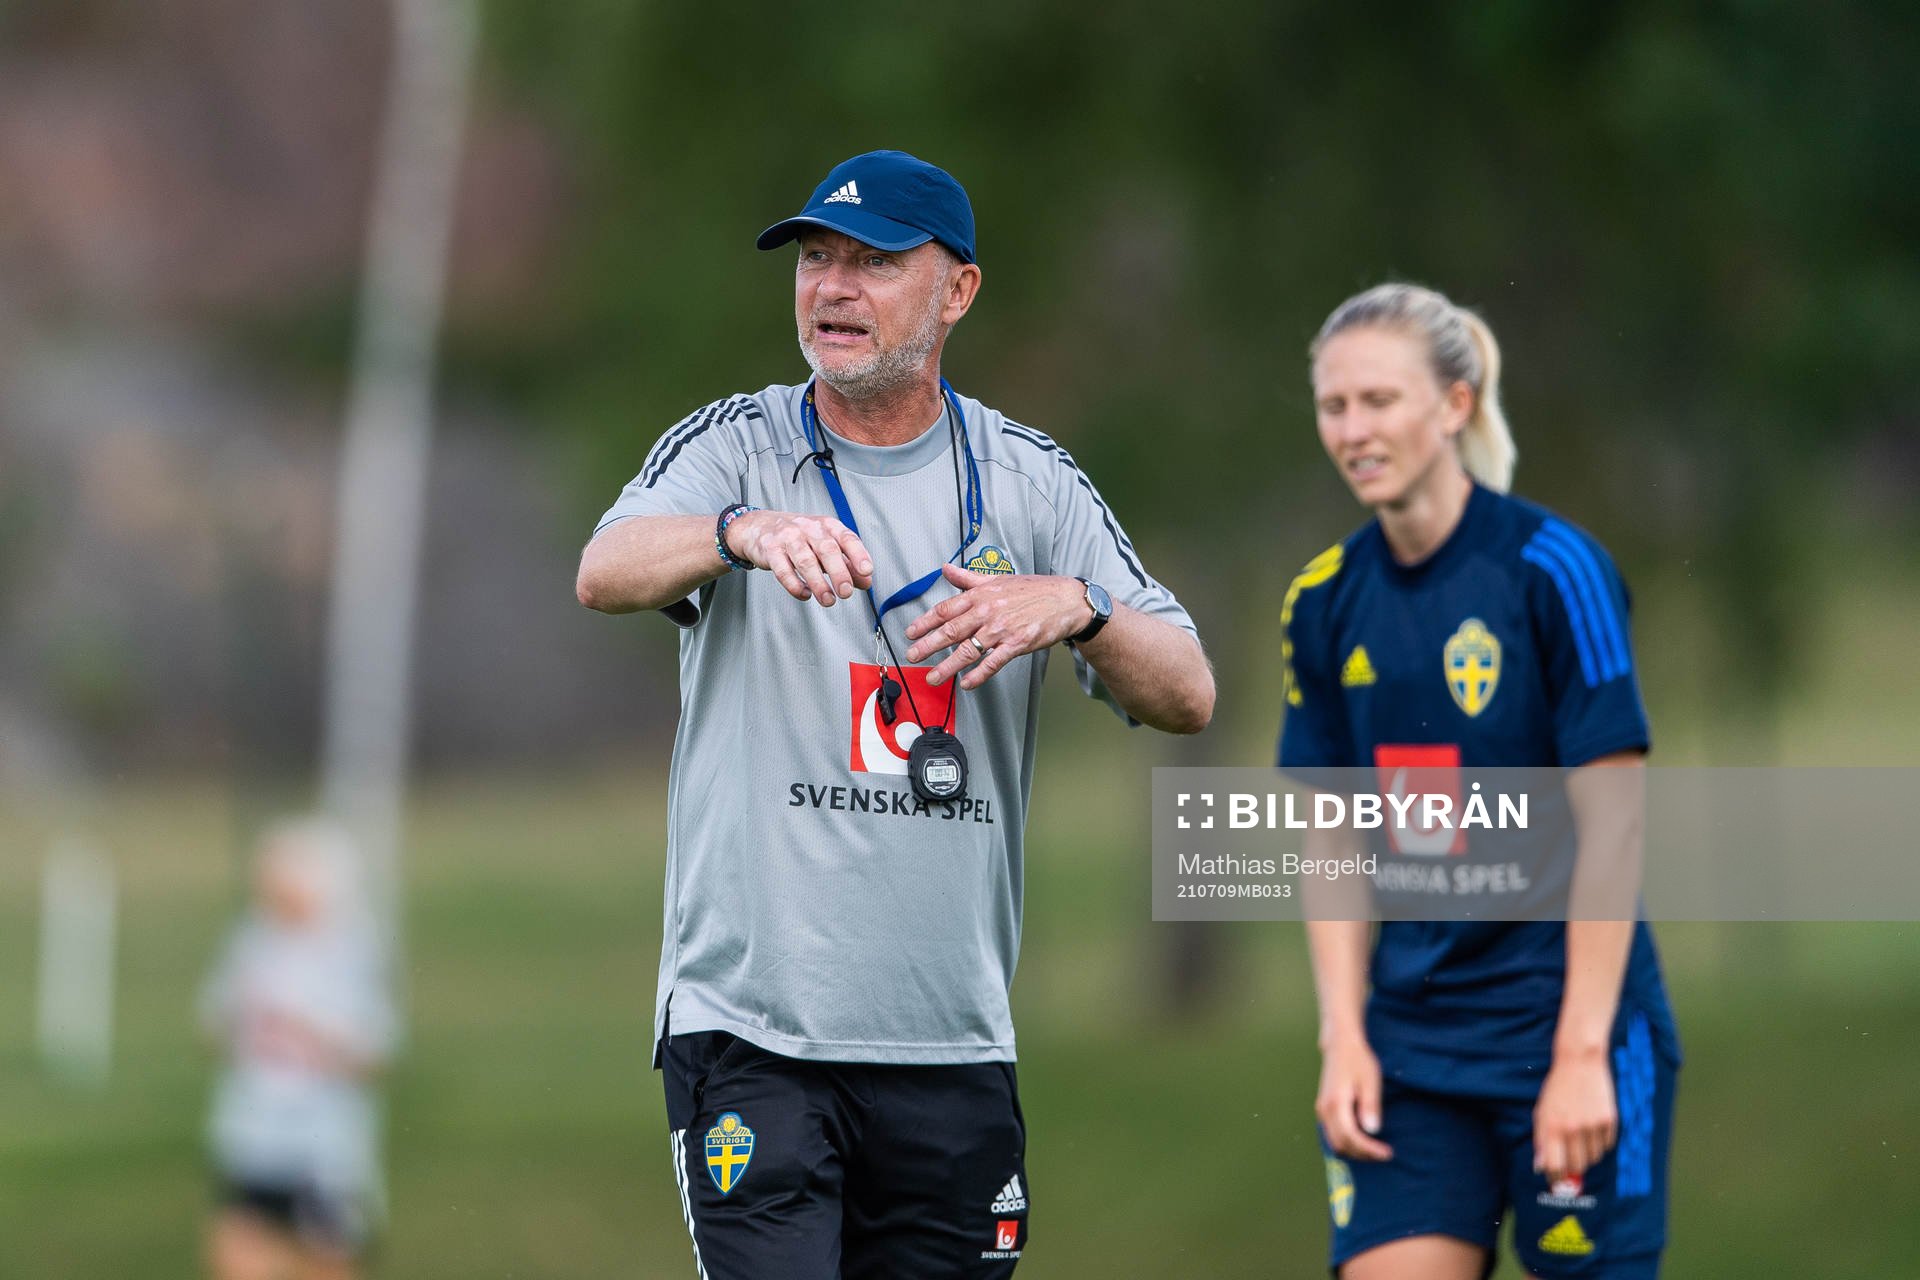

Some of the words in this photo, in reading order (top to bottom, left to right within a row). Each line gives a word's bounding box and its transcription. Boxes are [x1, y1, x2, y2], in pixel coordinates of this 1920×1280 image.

[823, 194, 862, 205] adidas
[789, 782, 932, 818] SVENSKA
[941, 797, 994, 825] SPEL
[1452, 861, 1531, 896] SPEL
[711, 1137, 746, 1145] SVERIGE
